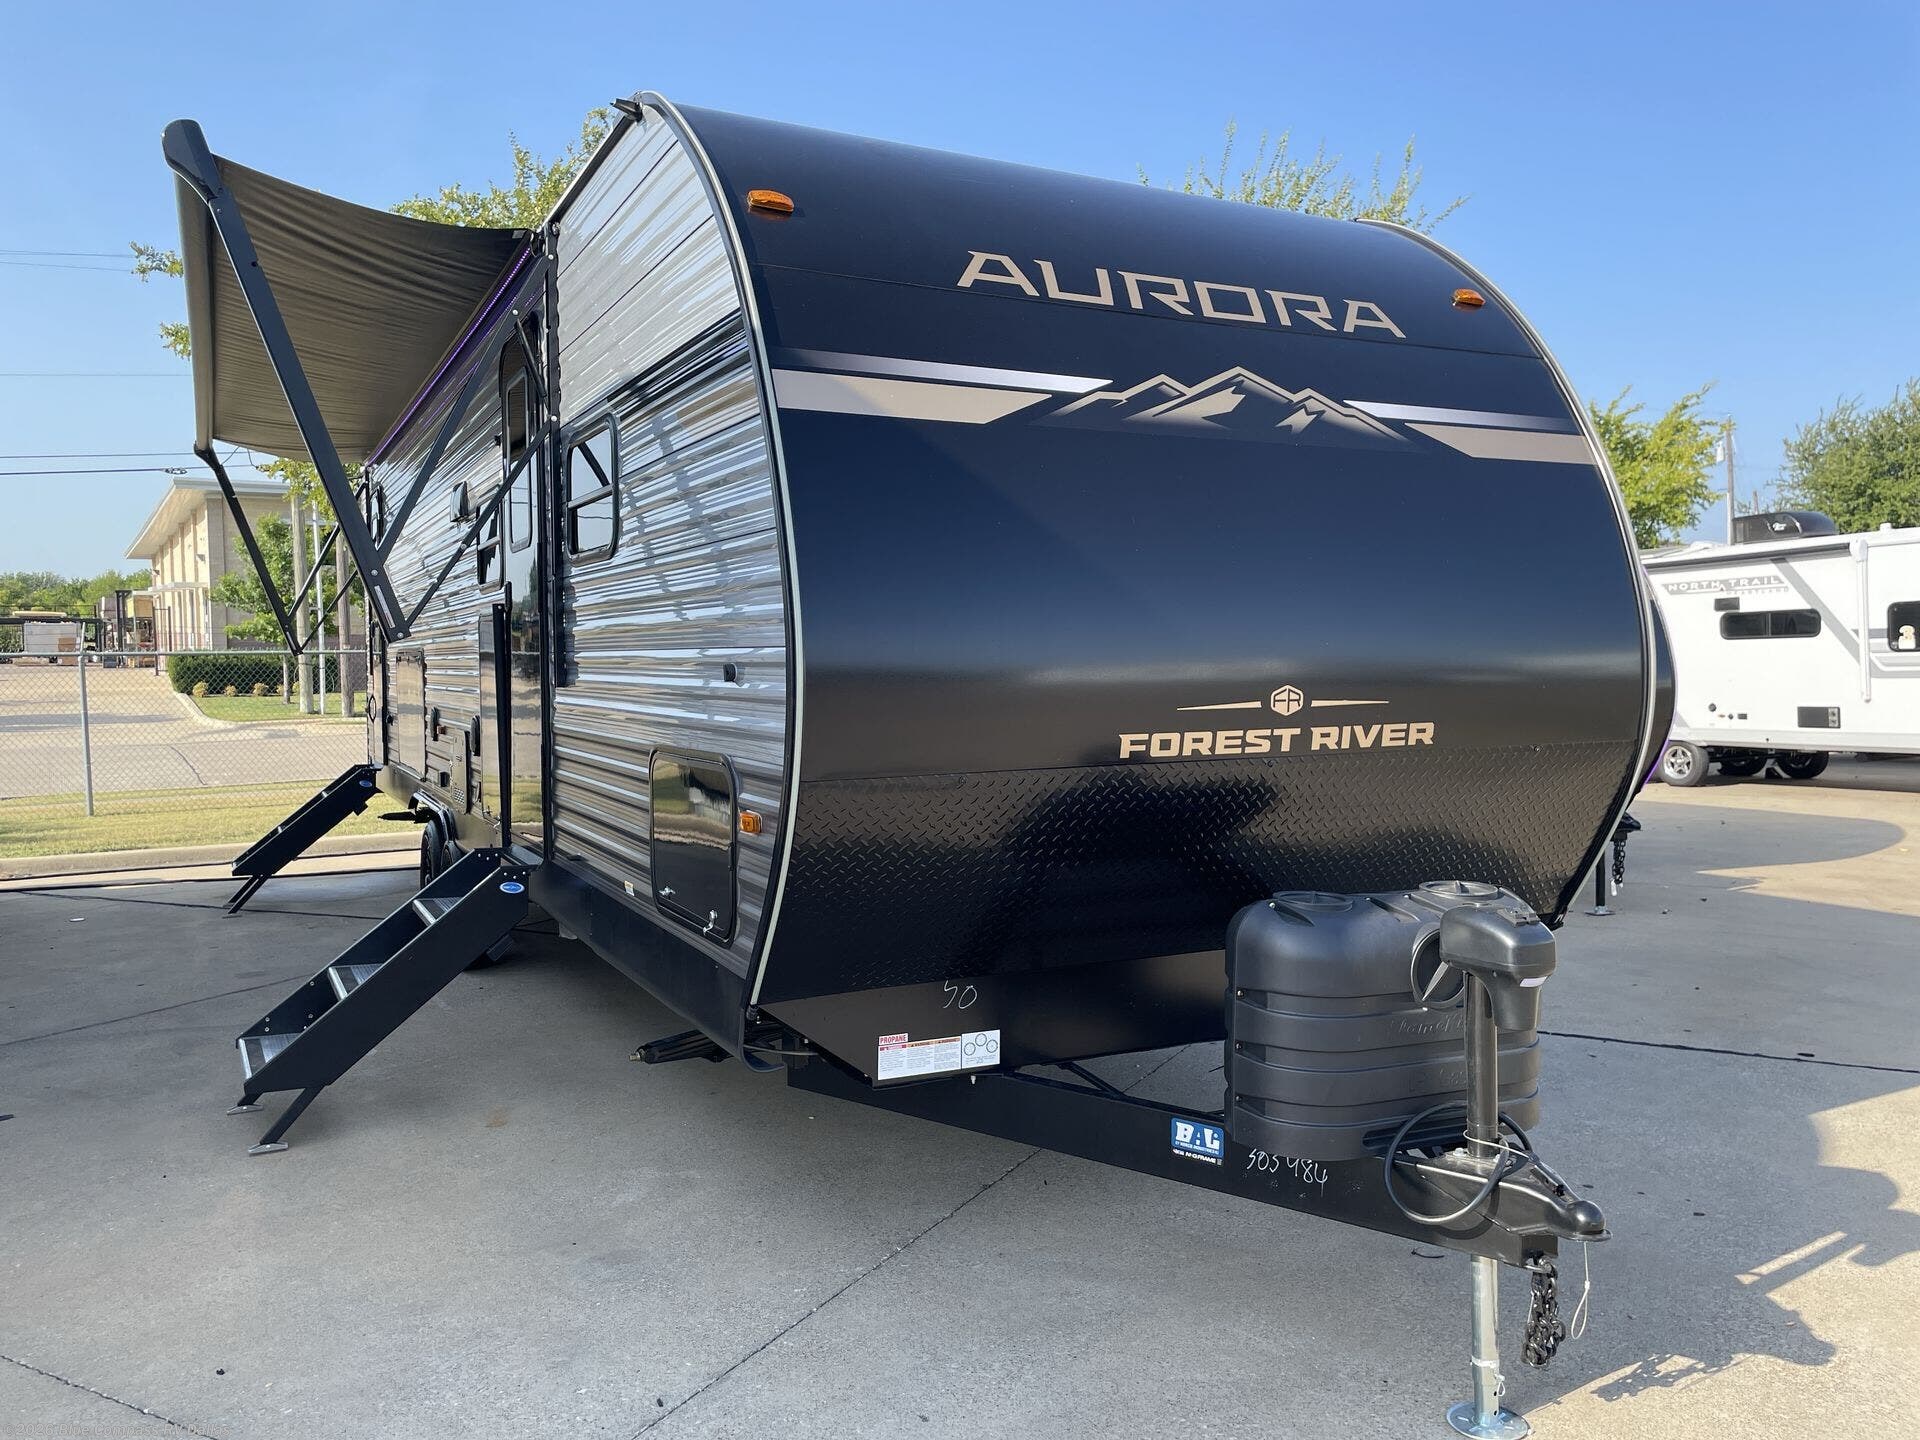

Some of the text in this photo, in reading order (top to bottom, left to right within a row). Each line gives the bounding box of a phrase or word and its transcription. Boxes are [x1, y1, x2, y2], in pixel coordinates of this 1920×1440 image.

[956, 250, 1406, 339] AURORA
[1667, 576, 1780, 593] NORTH TRAIL
[1119, 721, 1435, 759] FOREST RIVER
[879, 1034, 907, 1044] PROPANE
